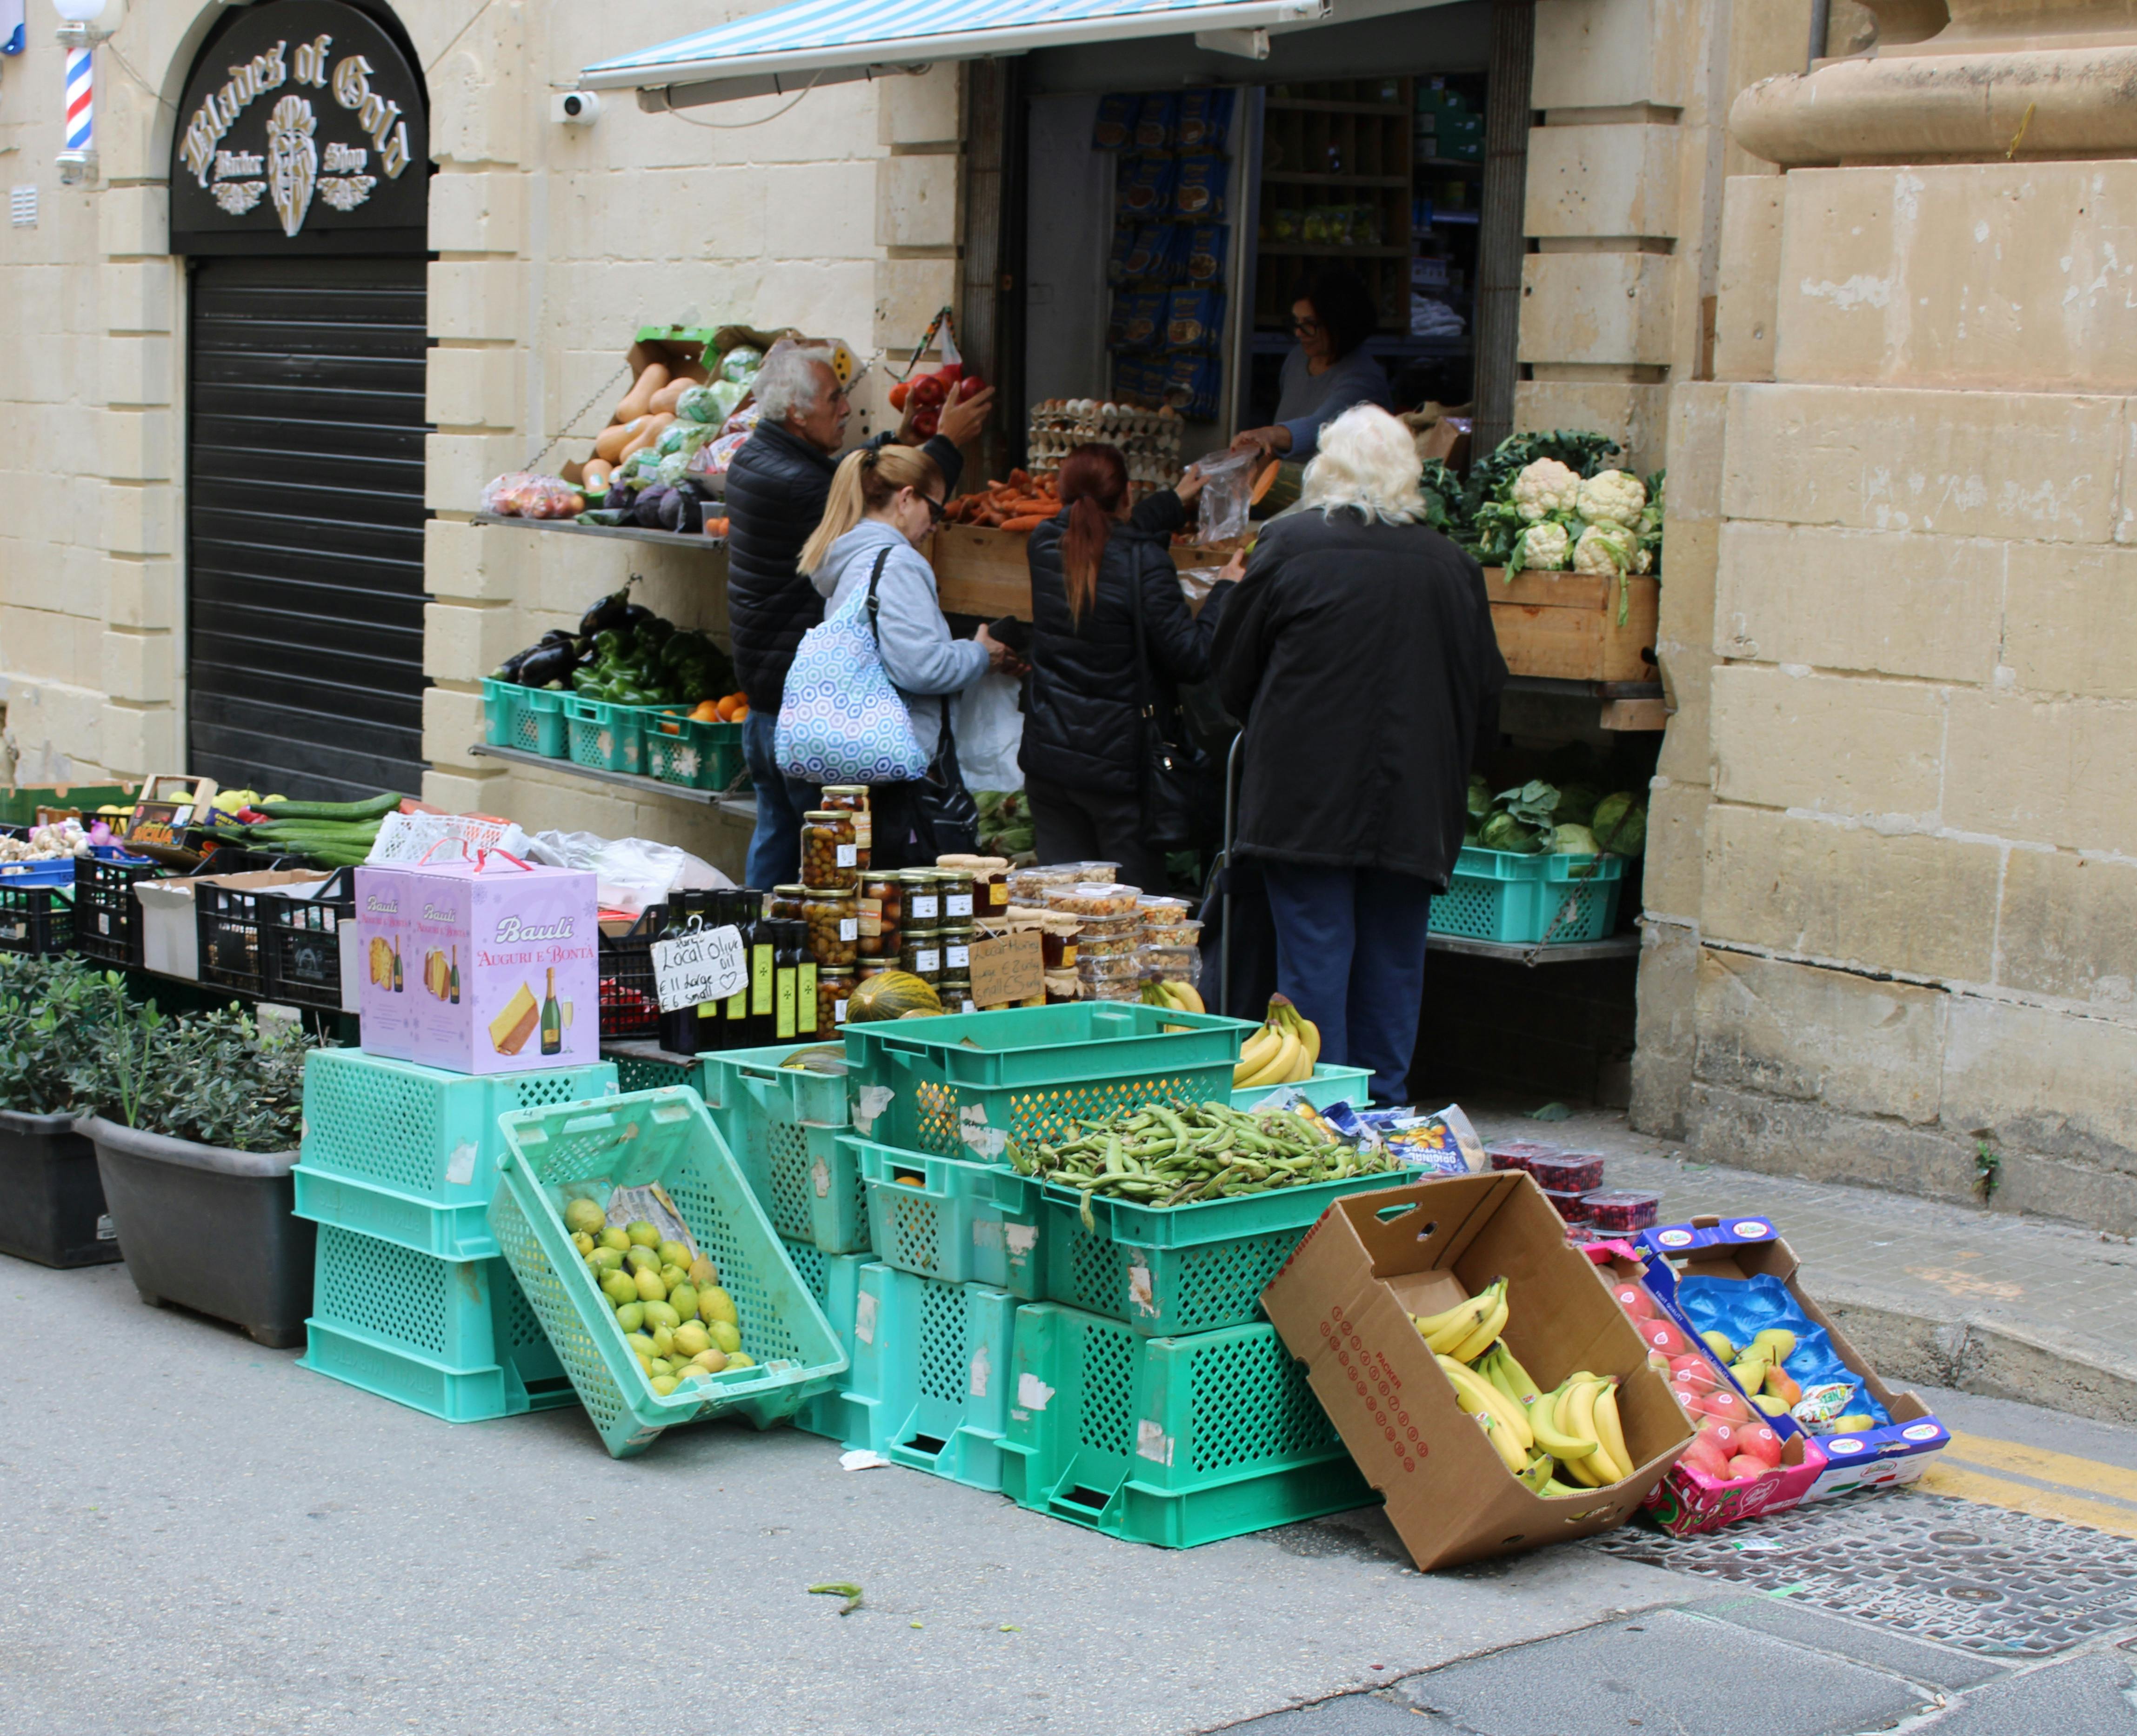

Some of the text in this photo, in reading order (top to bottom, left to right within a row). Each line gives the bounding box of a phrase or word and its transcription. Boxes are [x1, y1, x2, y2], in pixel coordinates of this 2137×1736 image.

[180, 34, 411, 188] Blades of Gold
[214, 150, 265, 181] Barber
[323, 142, 367, 174] Shop
[132, 826, 174, 845] SICILIA
[367, 895, 398, 914] Bauli
[423, 903, 456, 923] Bauli
[494, 914, 574, 944] Bauli
[477, 944, 594, 967] AUGURI E BONTÀ
[663, 942, 703, 972] Local
[708, 936, 739, 960] Olive
[1409, 1151, 1457, 1164] ORIGINAL
[1666, 1302, 1684, 1322] QUALITY
[1375, 1351, 1402, 1390] PACKER
[1804, 1582, 1984, 1636] CLARKSTEEL
